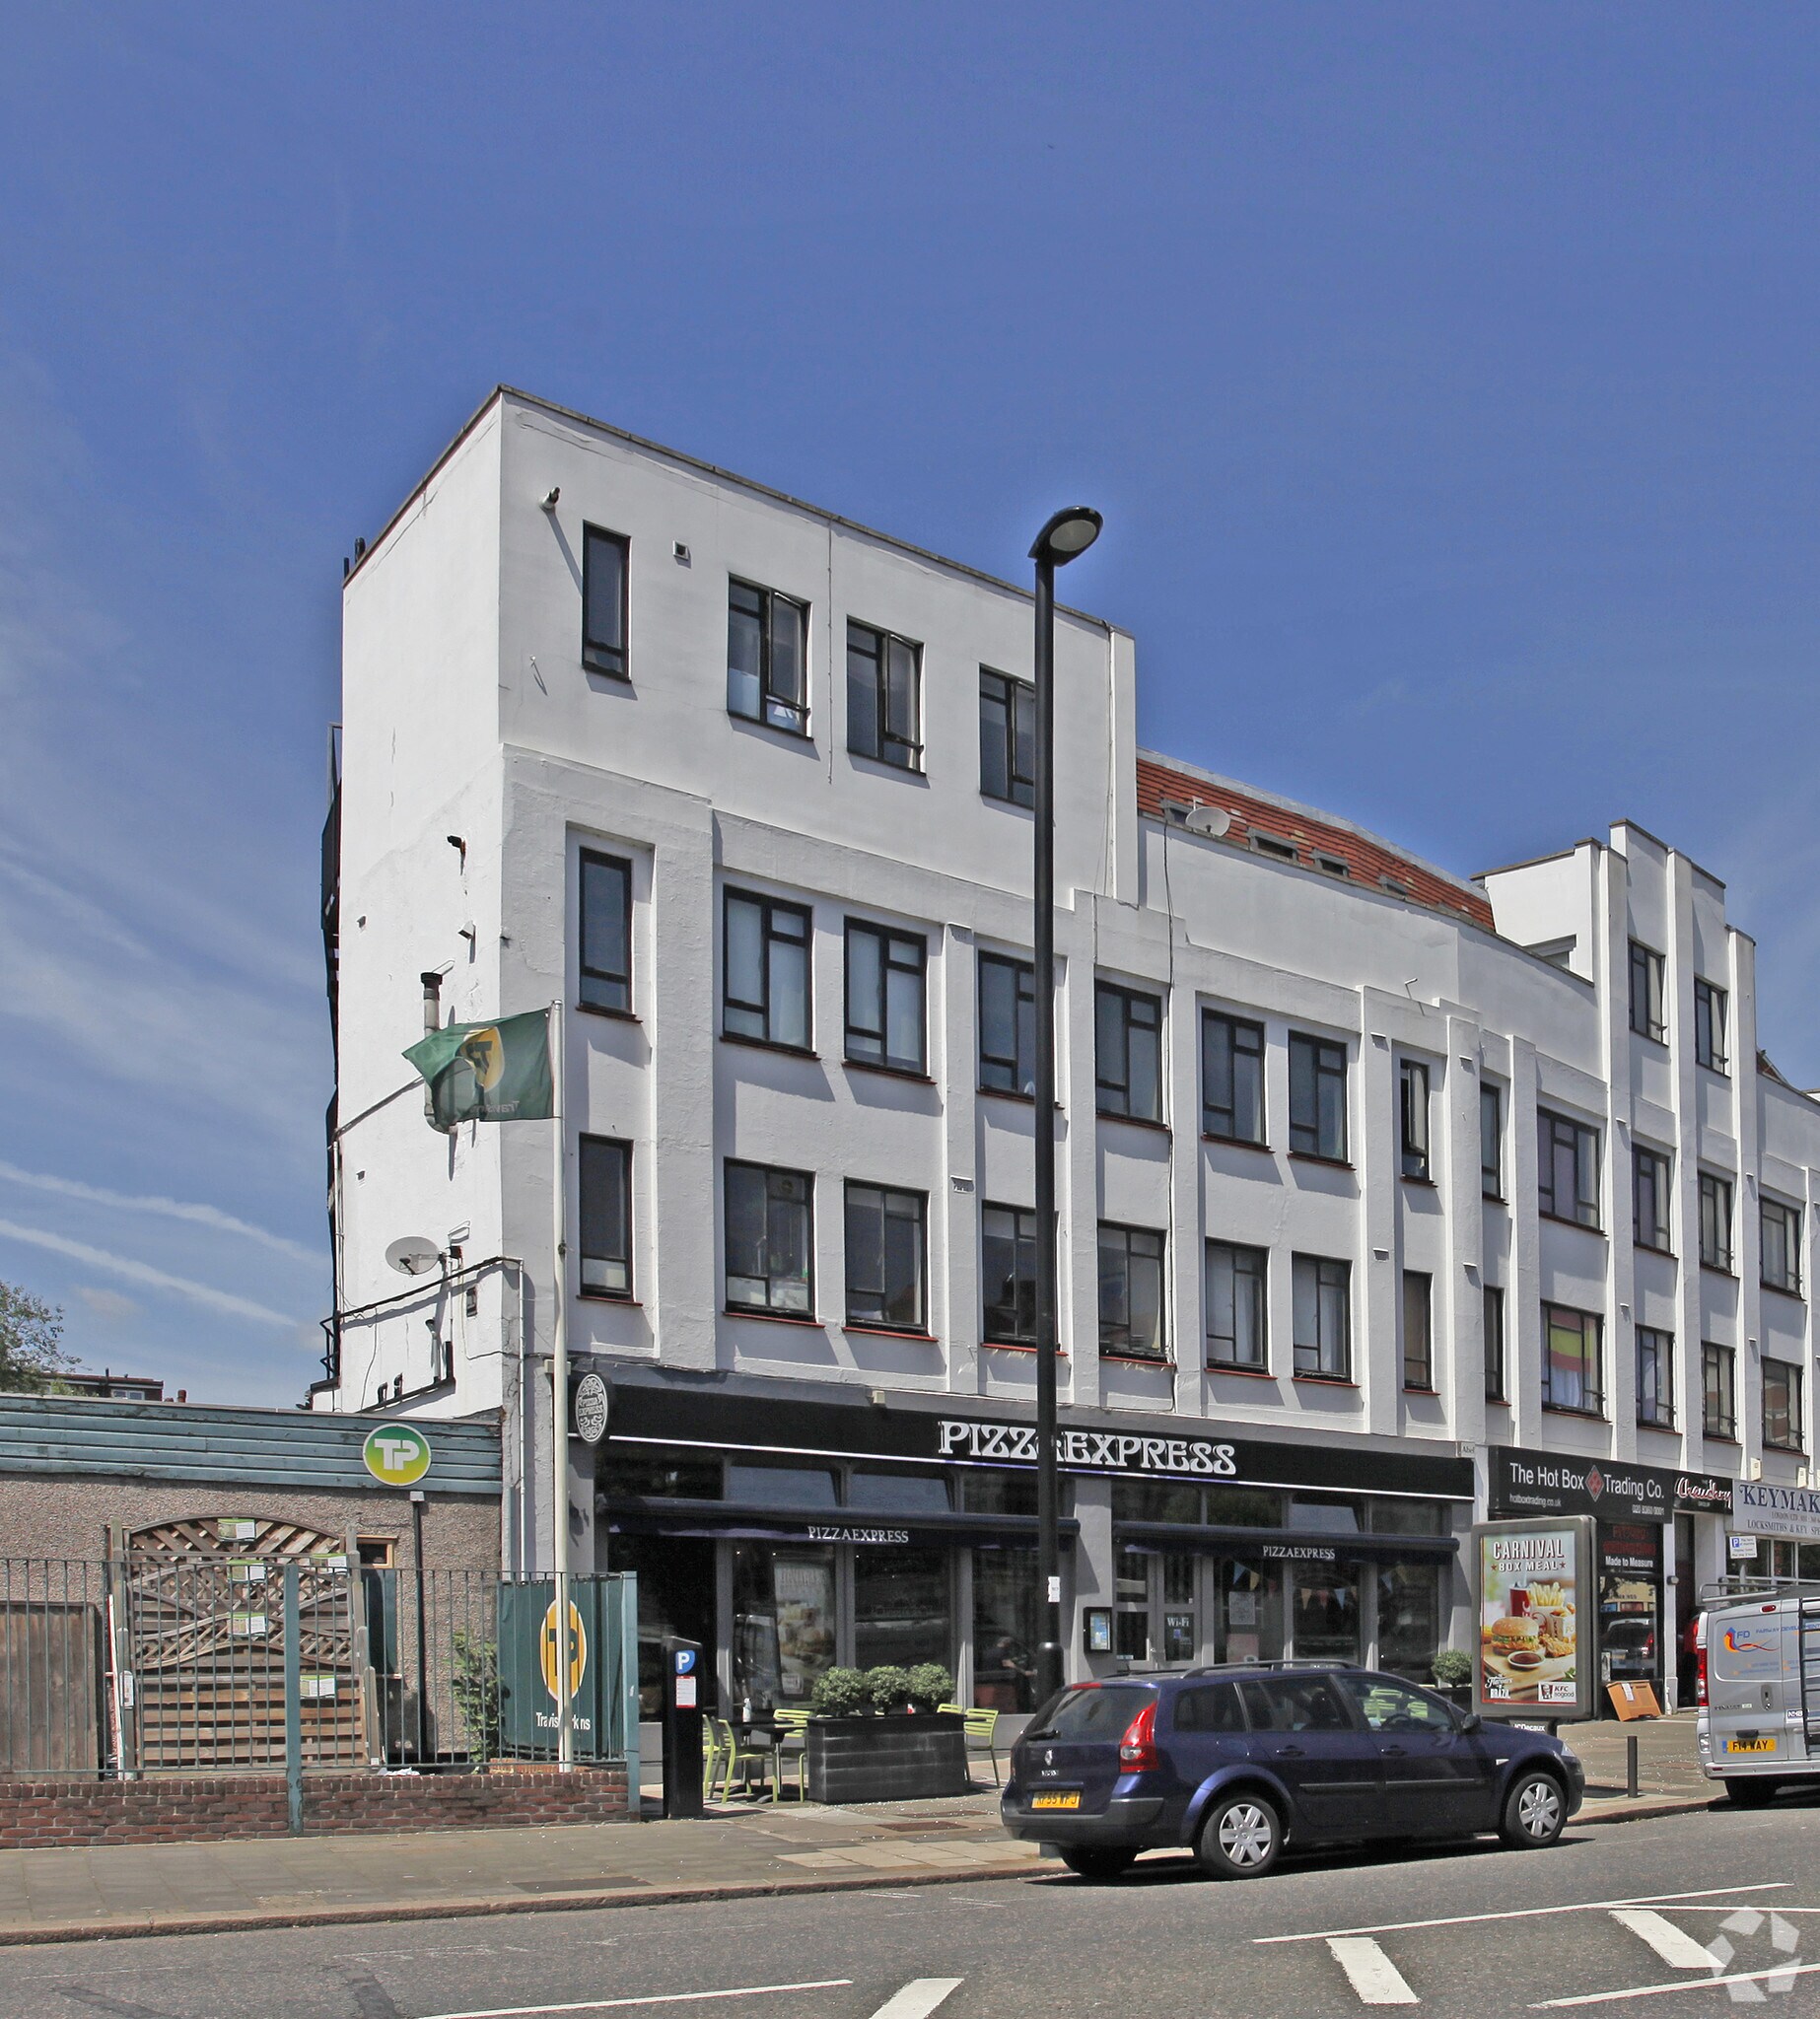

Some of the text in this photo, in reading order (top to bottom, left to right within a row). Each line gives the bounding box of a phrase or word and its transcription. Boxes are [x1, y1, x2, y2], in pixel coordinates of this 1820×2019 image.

[375, 1438, 419, 1470] TP
[1509, 1462, 1664, 1501] The Hot Box Trading Co.
[1747, 1519, 1786, 1532] LOCKSMITHS
[1795, 1525, 1807, 1534] KEY
[807, 1525, 909, 1544] PIZZAEXPRESS
[1263, 1545, 1335, 1560] PIZZAEXPRESS
[1493, 1539, 1565, 1560] CARNIVAL
[1499, 1561, 1559, 1572] BOX MEAL
[1606, 1556, 1653, 1567] Made to Measure
[1167, 1617, 1189, 1627] Wi-Fi
[1737, 1630, 1750, 1638] FD
